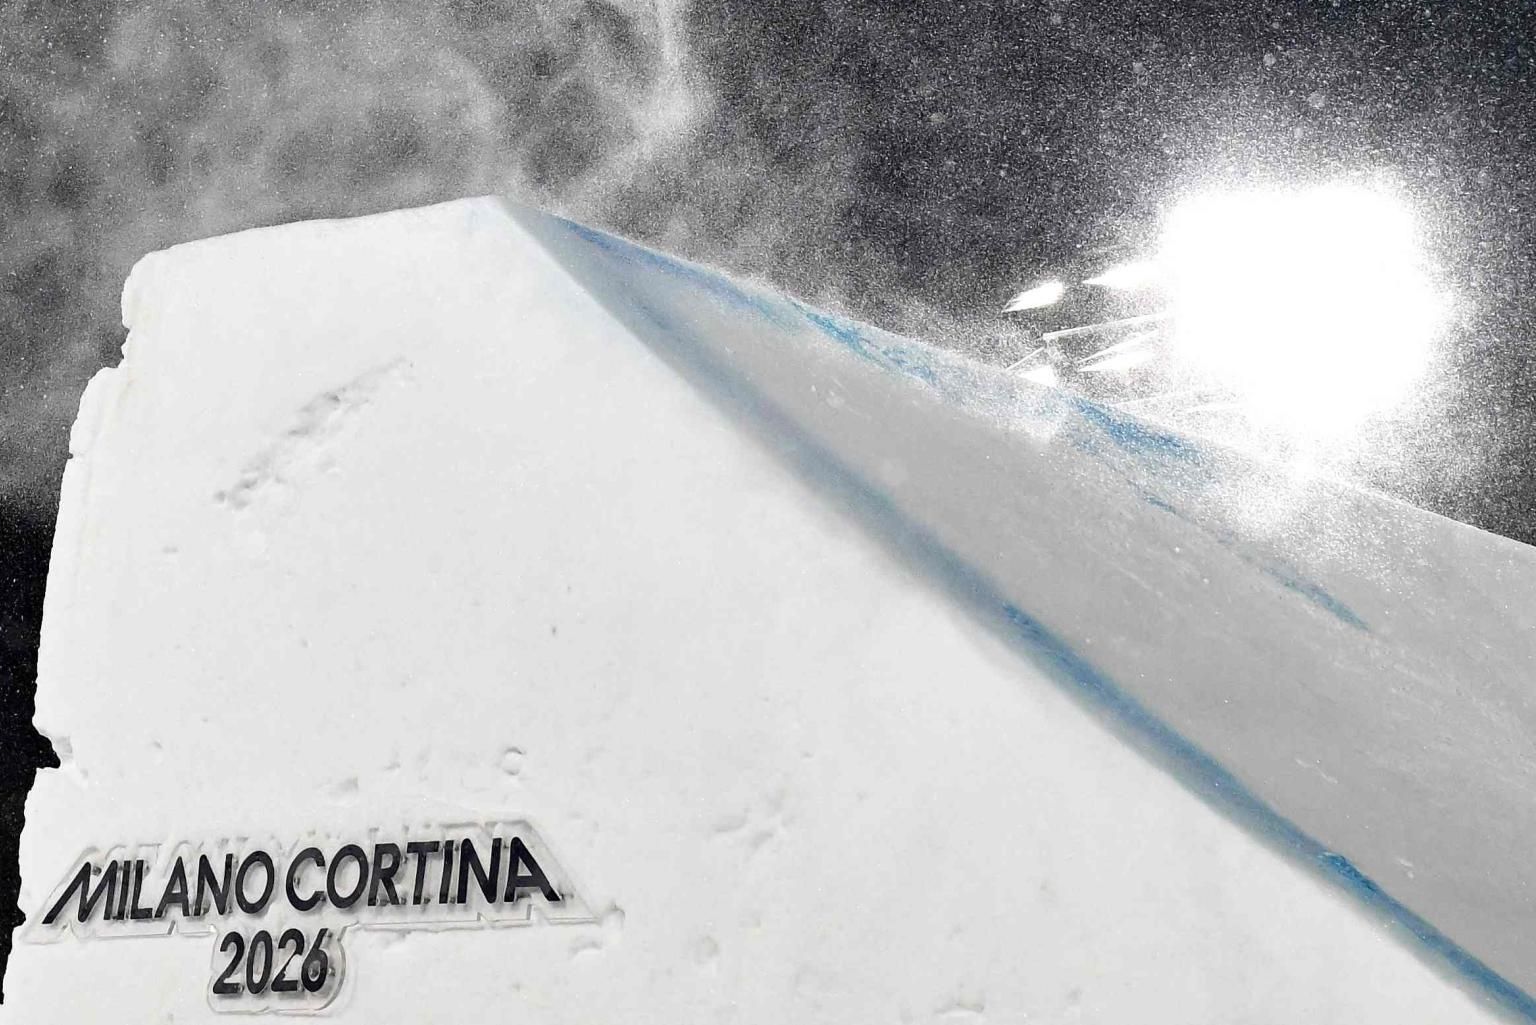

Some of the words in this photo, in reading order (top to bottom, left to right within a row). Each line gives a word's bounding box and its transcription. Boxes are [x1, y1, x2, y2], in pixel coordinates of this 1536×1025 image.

[41, 850, 275, 925] MILANO
[285, 836, 561, 912] CORTINA
[212, 927, 329, 995] 2026
